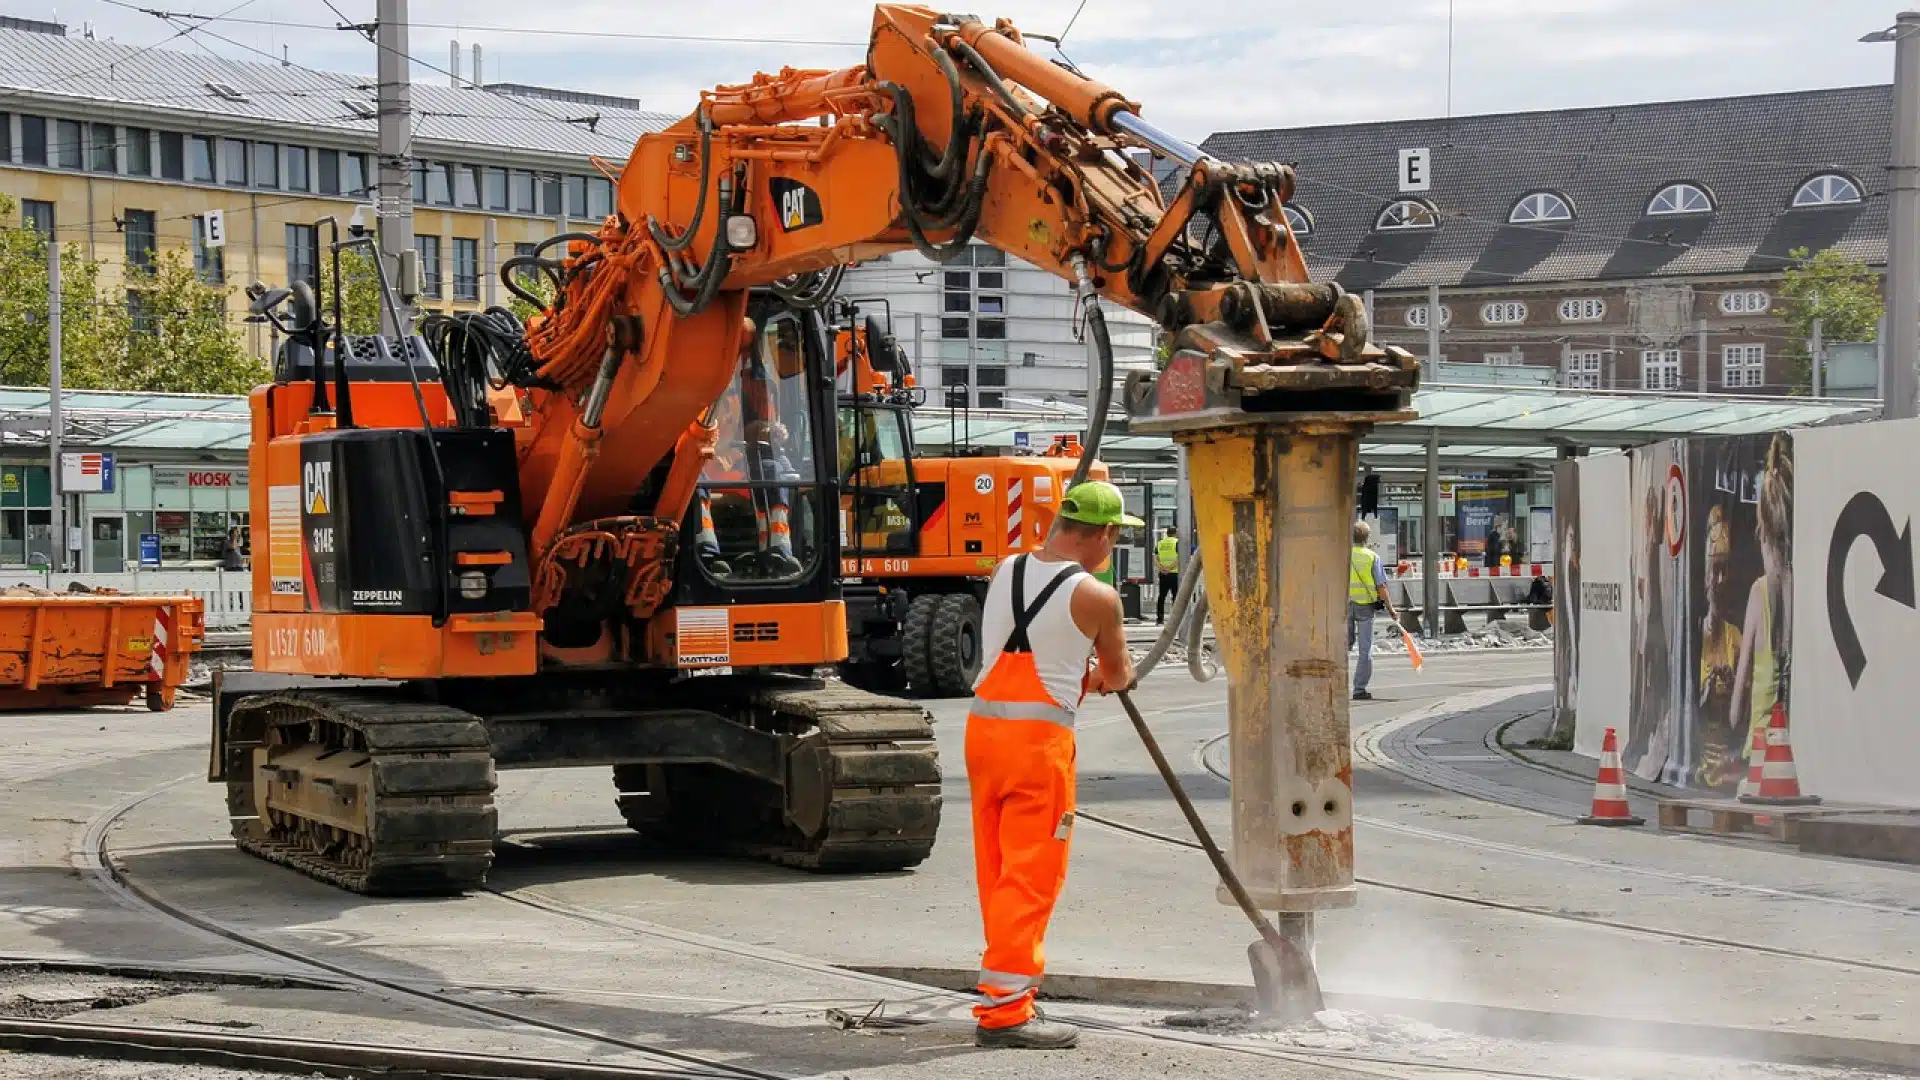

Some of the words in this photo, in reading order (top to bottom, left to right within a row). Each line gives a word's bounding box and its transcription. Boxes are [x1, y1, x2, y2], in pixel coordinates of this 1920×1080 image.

[1408, 156, 1421, 184] E
[782, 187, 805, 229] CAT
[210, 216, 220, 241] E
[188, 472, 232, 486] KIOSK
[304, 461, 331, 514] CAT
[977, 478, 992, 490] 20
[313, 527, 334, 553] 314E
[884, 559, 909, 572] 600
[353, 590, 403, 601] ZEPPELIN
[304, 628, 325, 657] 600
